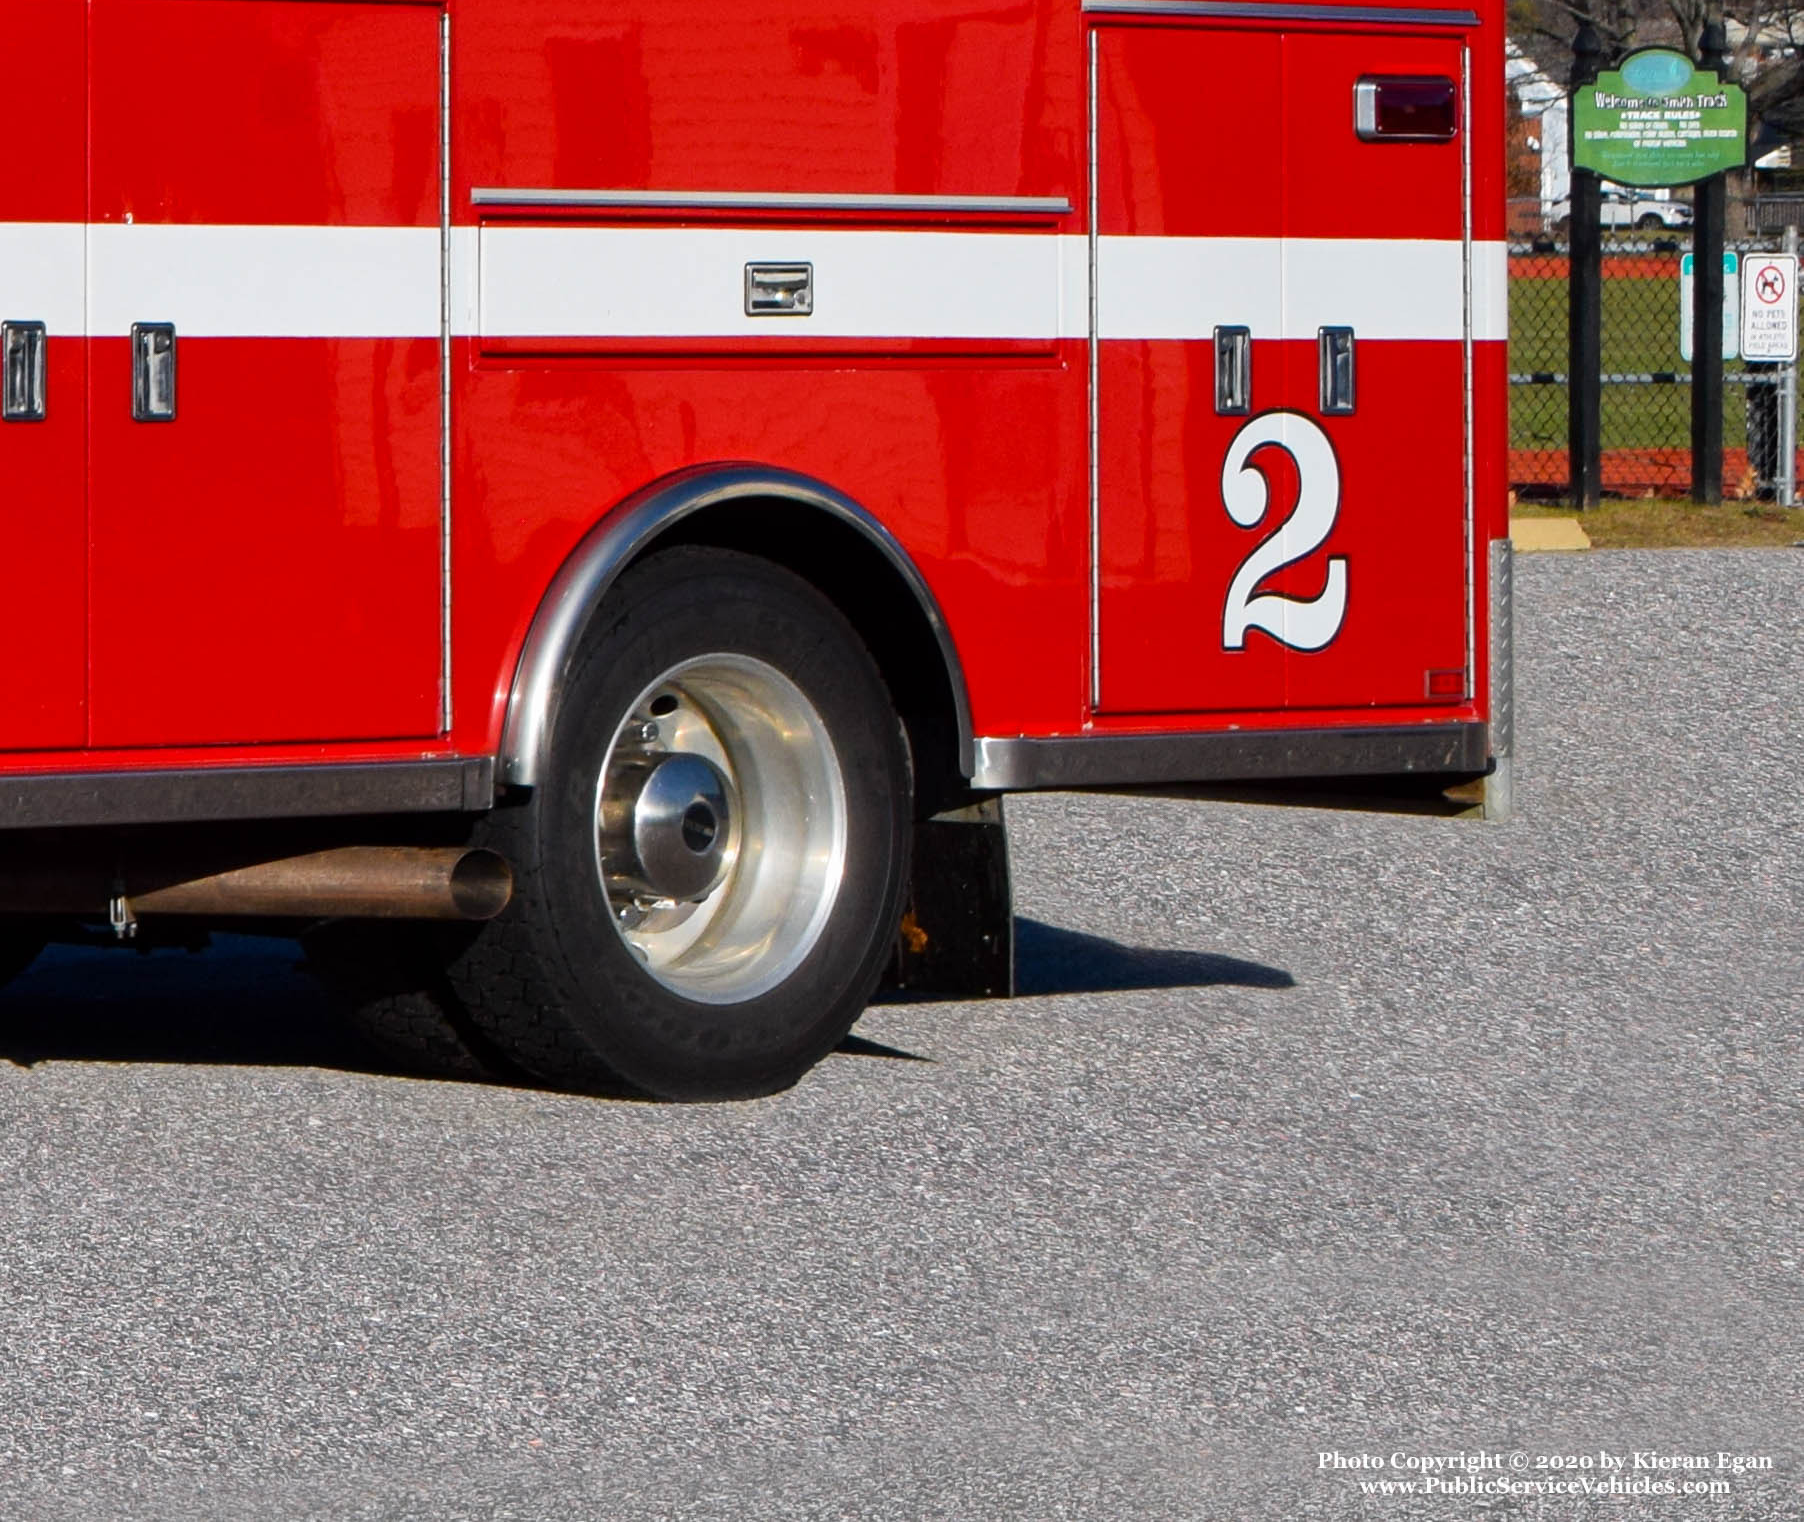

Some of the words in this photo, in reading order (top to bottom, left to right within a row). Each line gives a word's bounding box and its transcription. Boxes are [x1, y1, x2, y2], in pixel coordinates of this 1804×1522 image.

[1595, 91, 1644, 109] Welcome
[1696, 93, 1729, 109] Track
[1221, 410, 1349, 652] 2
